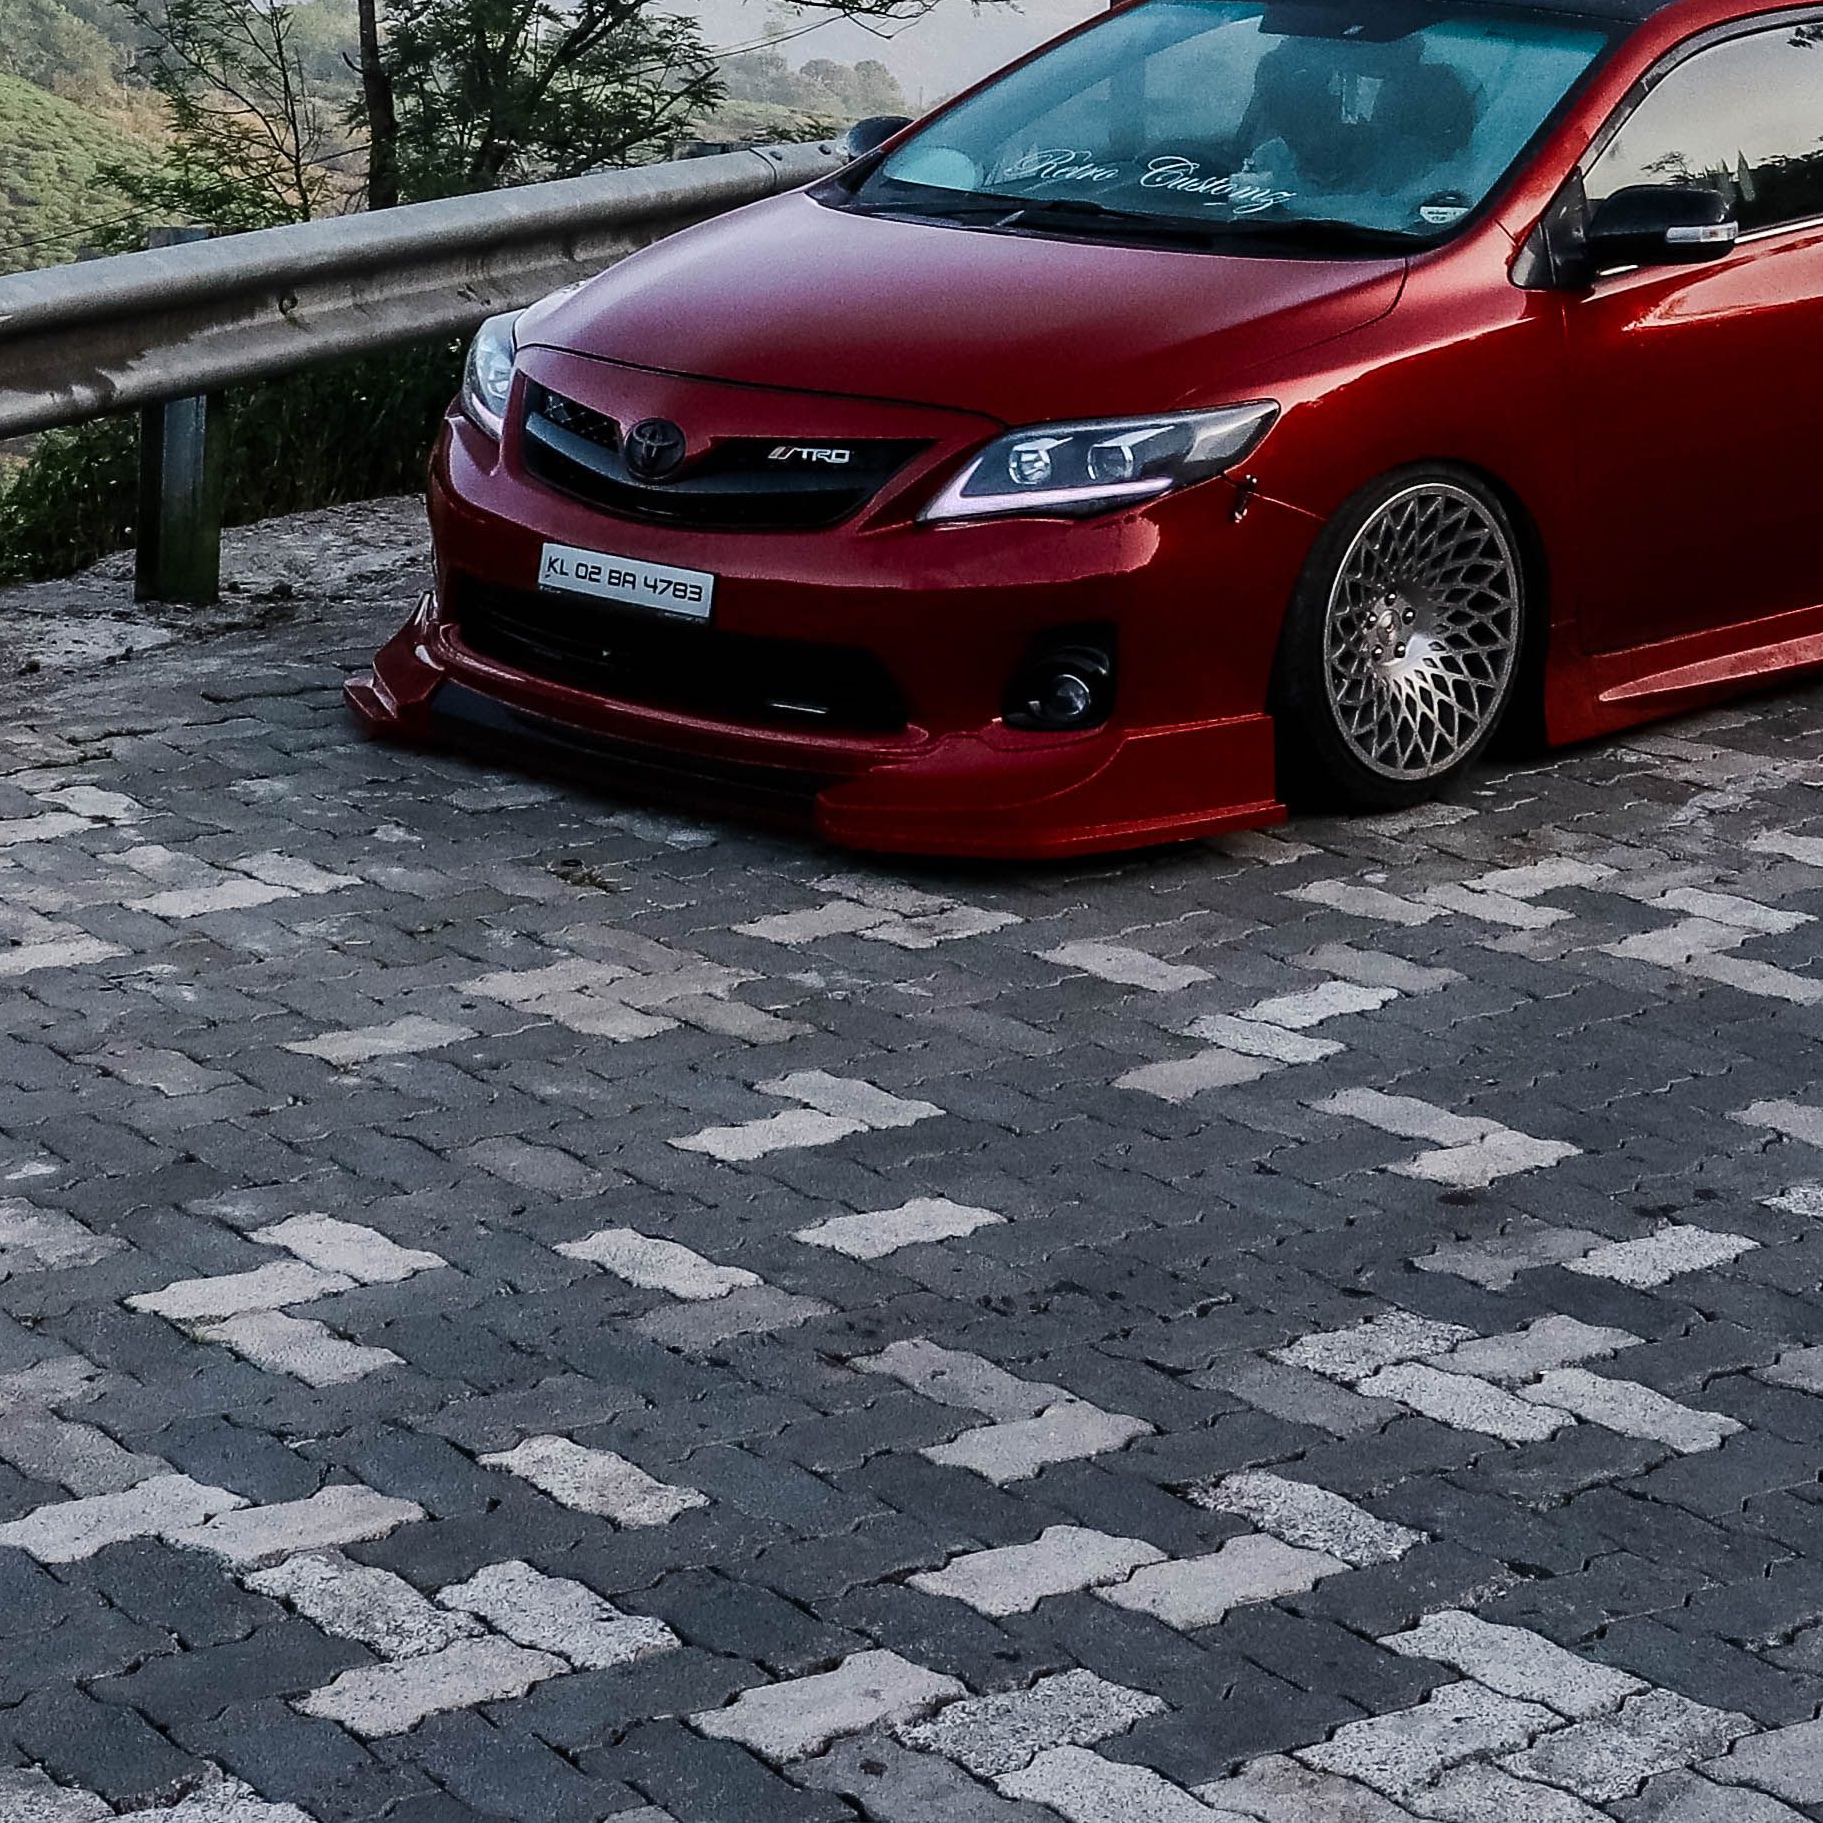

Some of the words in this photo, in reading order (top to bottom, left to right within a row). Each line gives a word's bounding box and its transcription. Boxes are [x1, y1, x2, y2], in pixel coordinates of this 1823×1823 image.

[1004, 149, 1119, 179] Retro
[547, 556, 569, 576] KL
[575, 562, 602, 583] 02
[607, 569, 636, 590] BA
[643, 576, 703, 603] 4783
